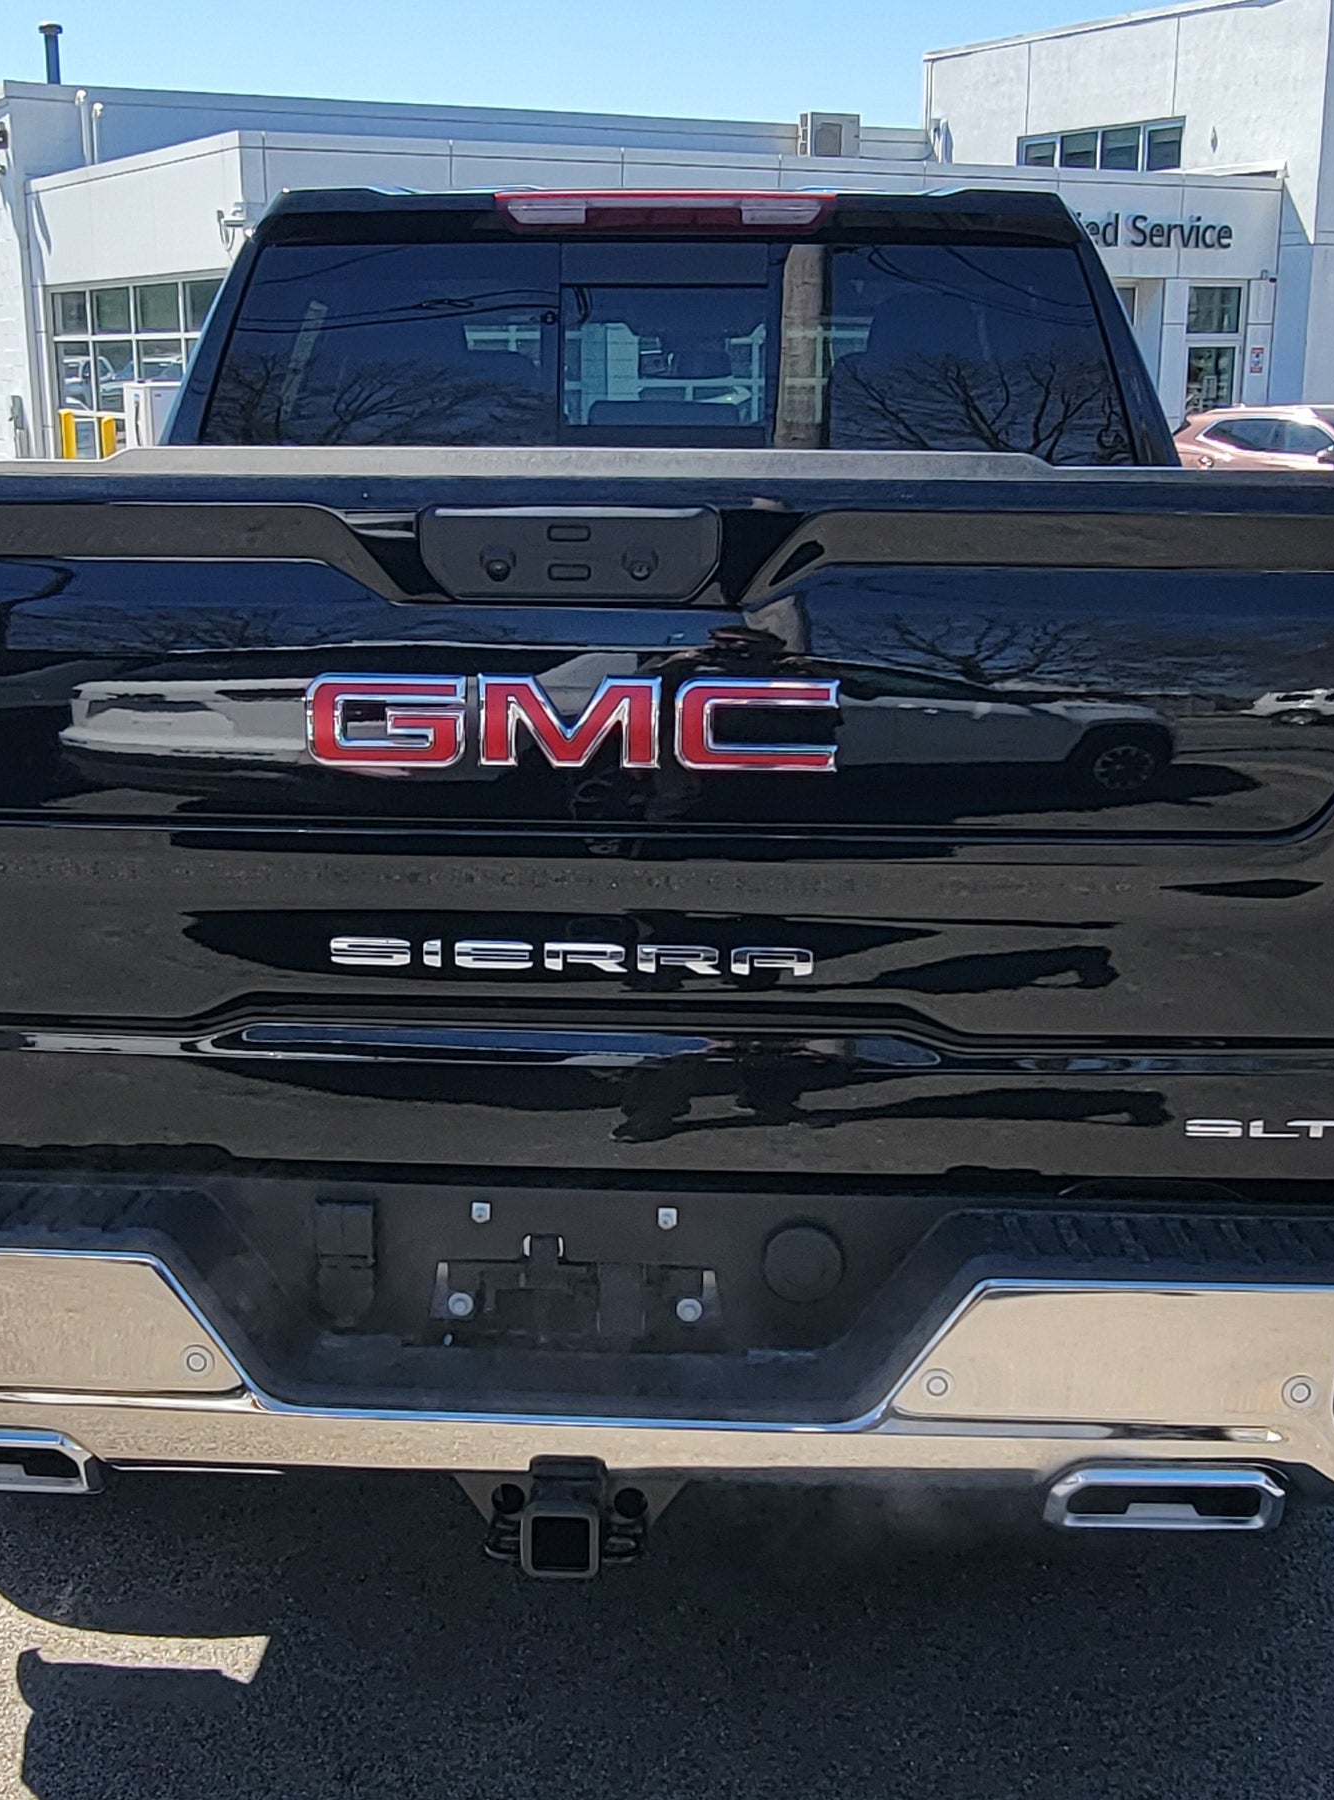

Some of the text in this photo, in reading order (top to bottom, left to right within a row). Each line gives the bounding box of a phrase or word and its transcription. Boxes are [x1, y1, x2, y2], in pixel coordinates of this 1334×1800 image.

[1130, 215, 1233, 249] Service
[306, 673, 841, 773] GMC
[330, 936, 814, 977] SIERRA
